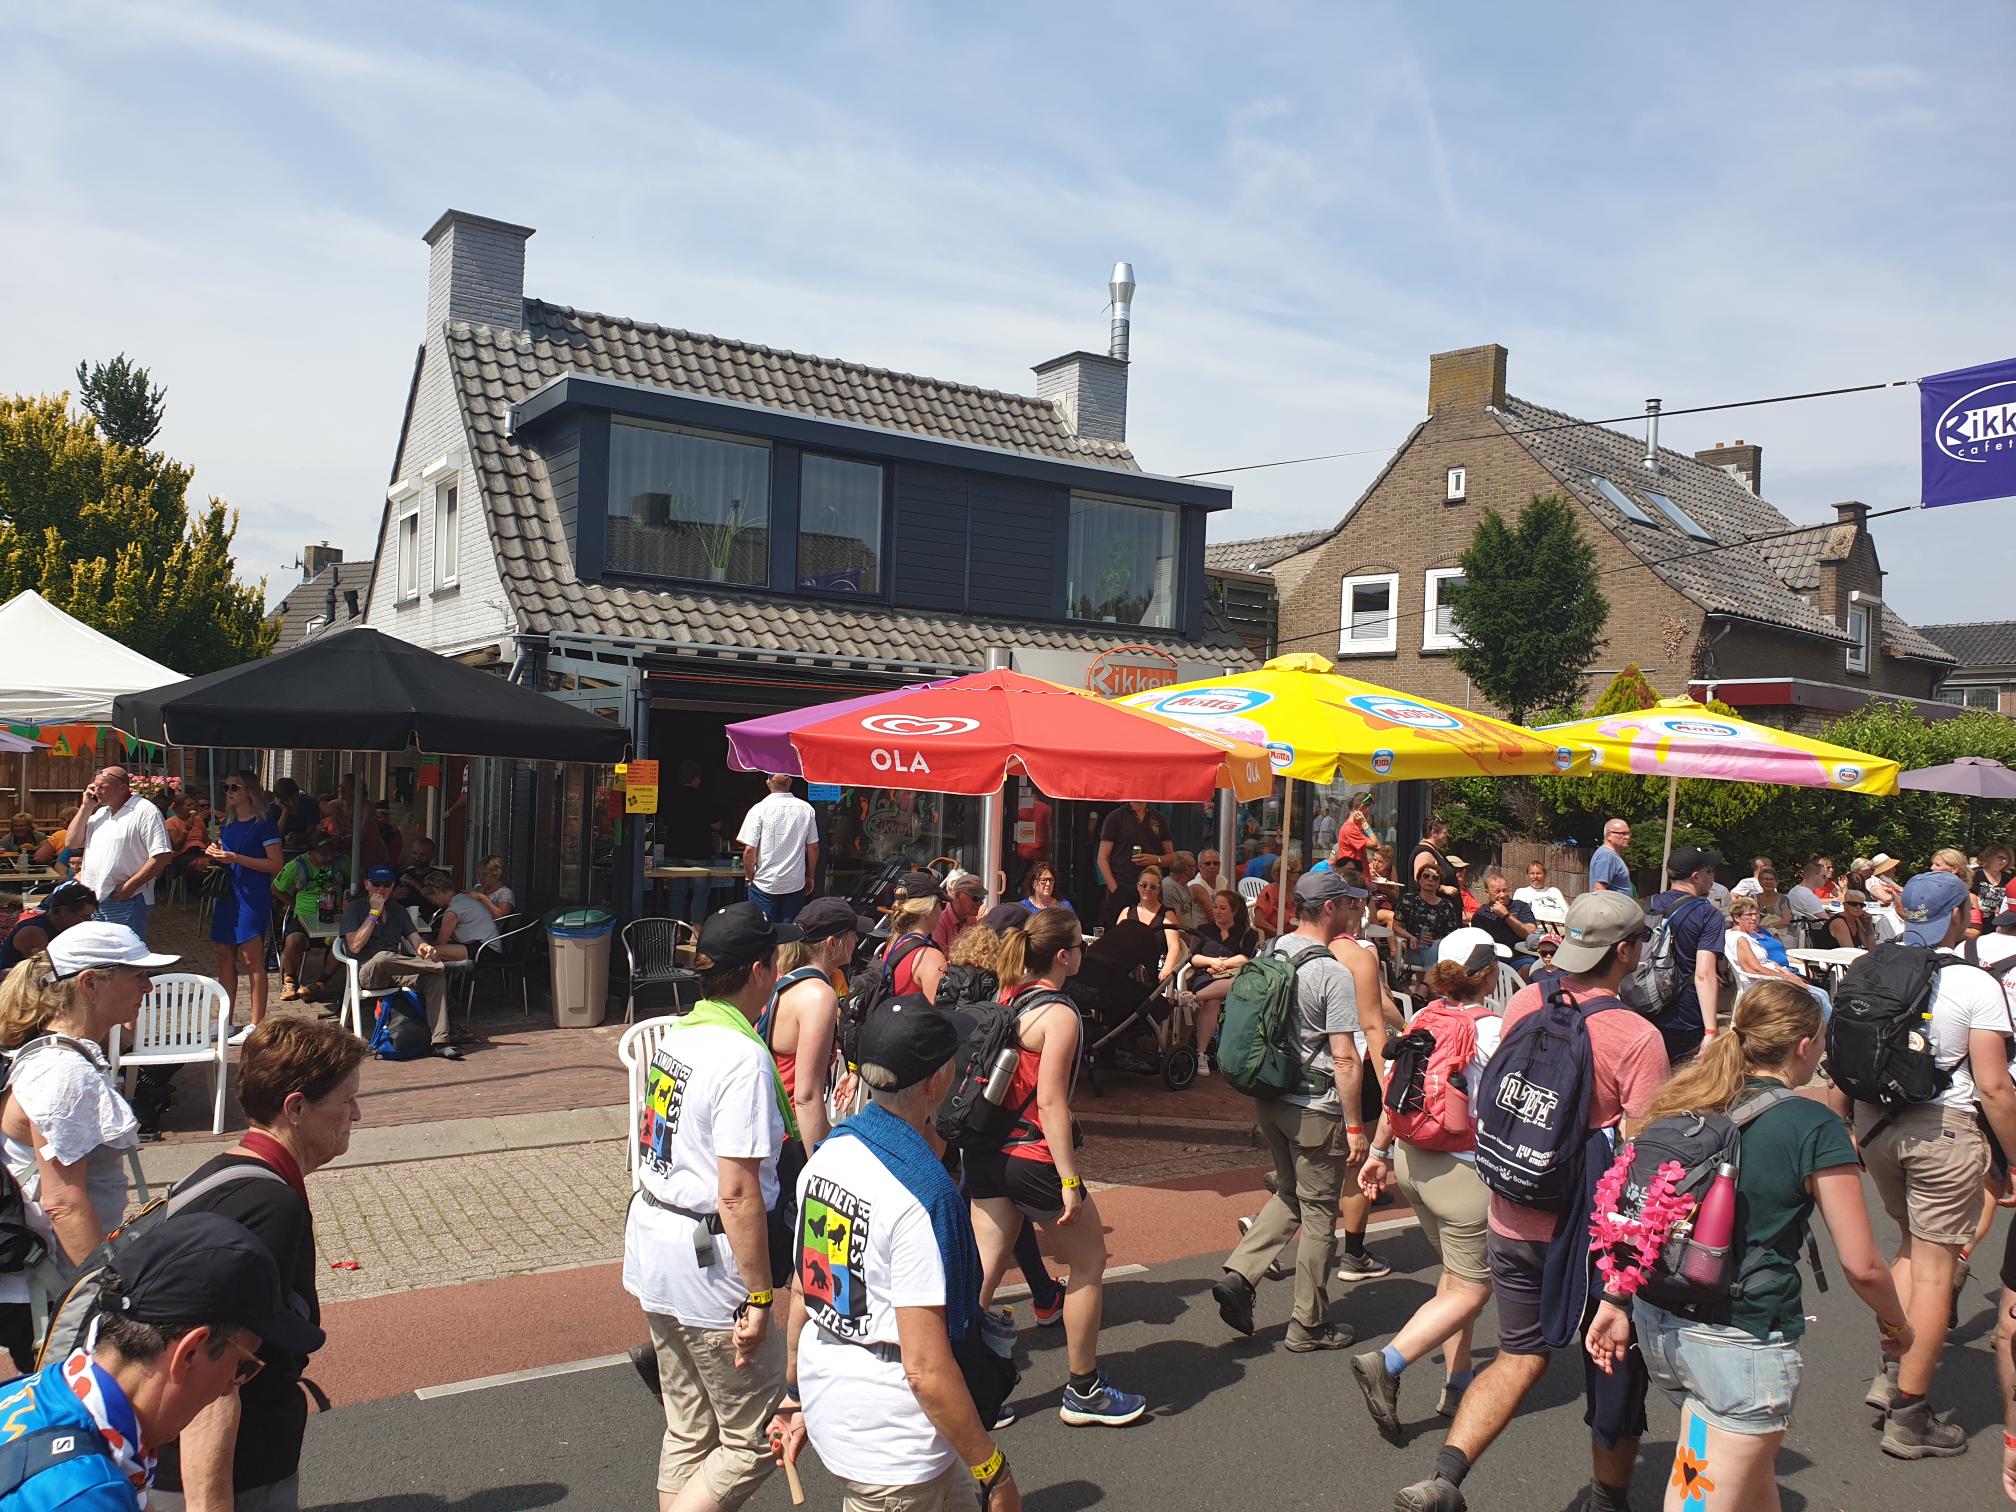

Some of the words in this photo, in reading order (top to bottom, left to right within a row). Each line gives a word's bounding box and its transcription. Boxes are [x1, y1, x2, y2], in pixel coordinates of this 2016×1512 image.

[1167, 697, 1242, 711] Motta
[870, 748, 931, 774] OLA
[1270, 750, 1291, 762] Motta
[1245, 761, 1261, 784] OLA
[652, 1048, 683, 1079] KINDER
[666, 1064, 694, 1135] BEEST
[1476, 1154, 1499, 1173] Mitland
[808, 1174, 858, 1217] KINDER
[848, 1198, 872, 1286] BEEST
[815, 1303, 873, 1338] FEEST
